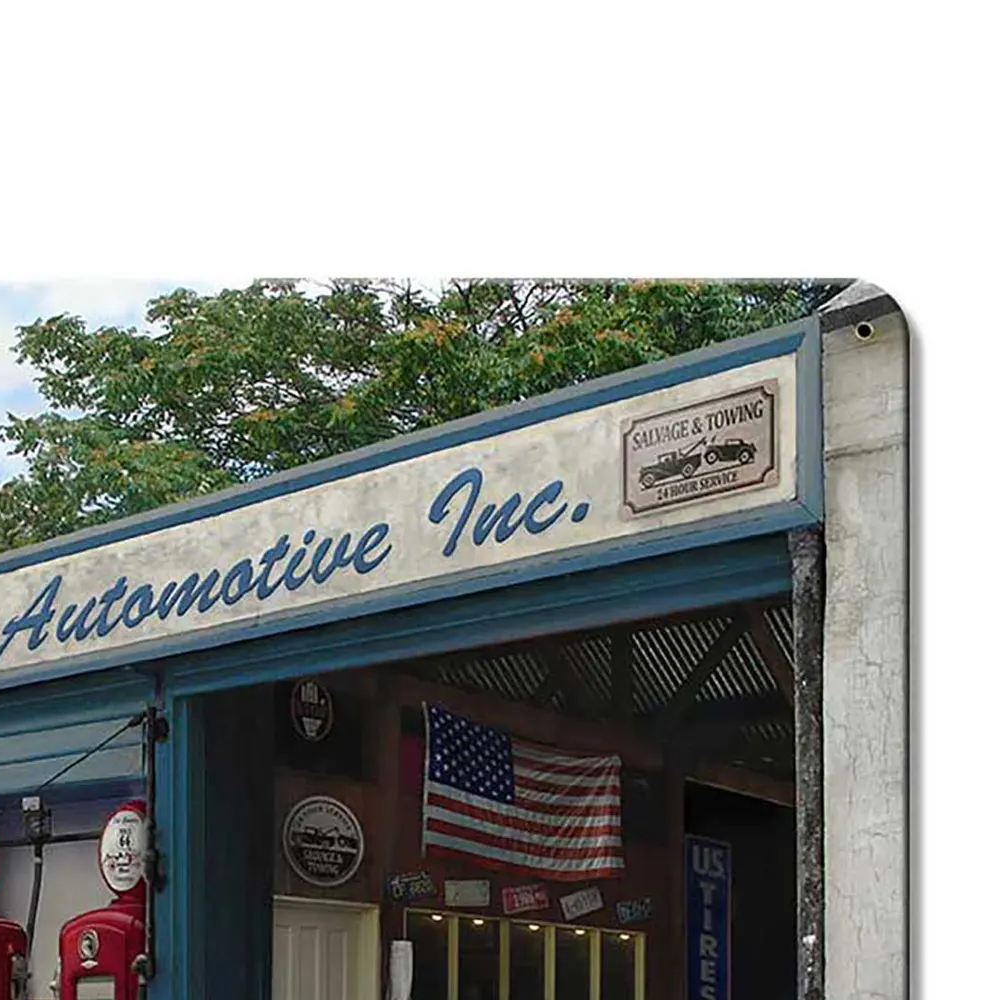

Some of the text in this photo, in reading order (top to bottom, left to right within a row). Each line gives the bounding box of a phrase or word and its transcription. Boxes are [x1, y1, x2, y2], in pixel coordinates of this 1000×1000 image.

[632, 399, 764, 452] SALVAGE & TOWING
[669, 481, 699, 497] HOUR
[699, 471, 739, 491] SERVICE
[428, 467, 592, 558] Inc.
[692, 844, 724, 878] US
